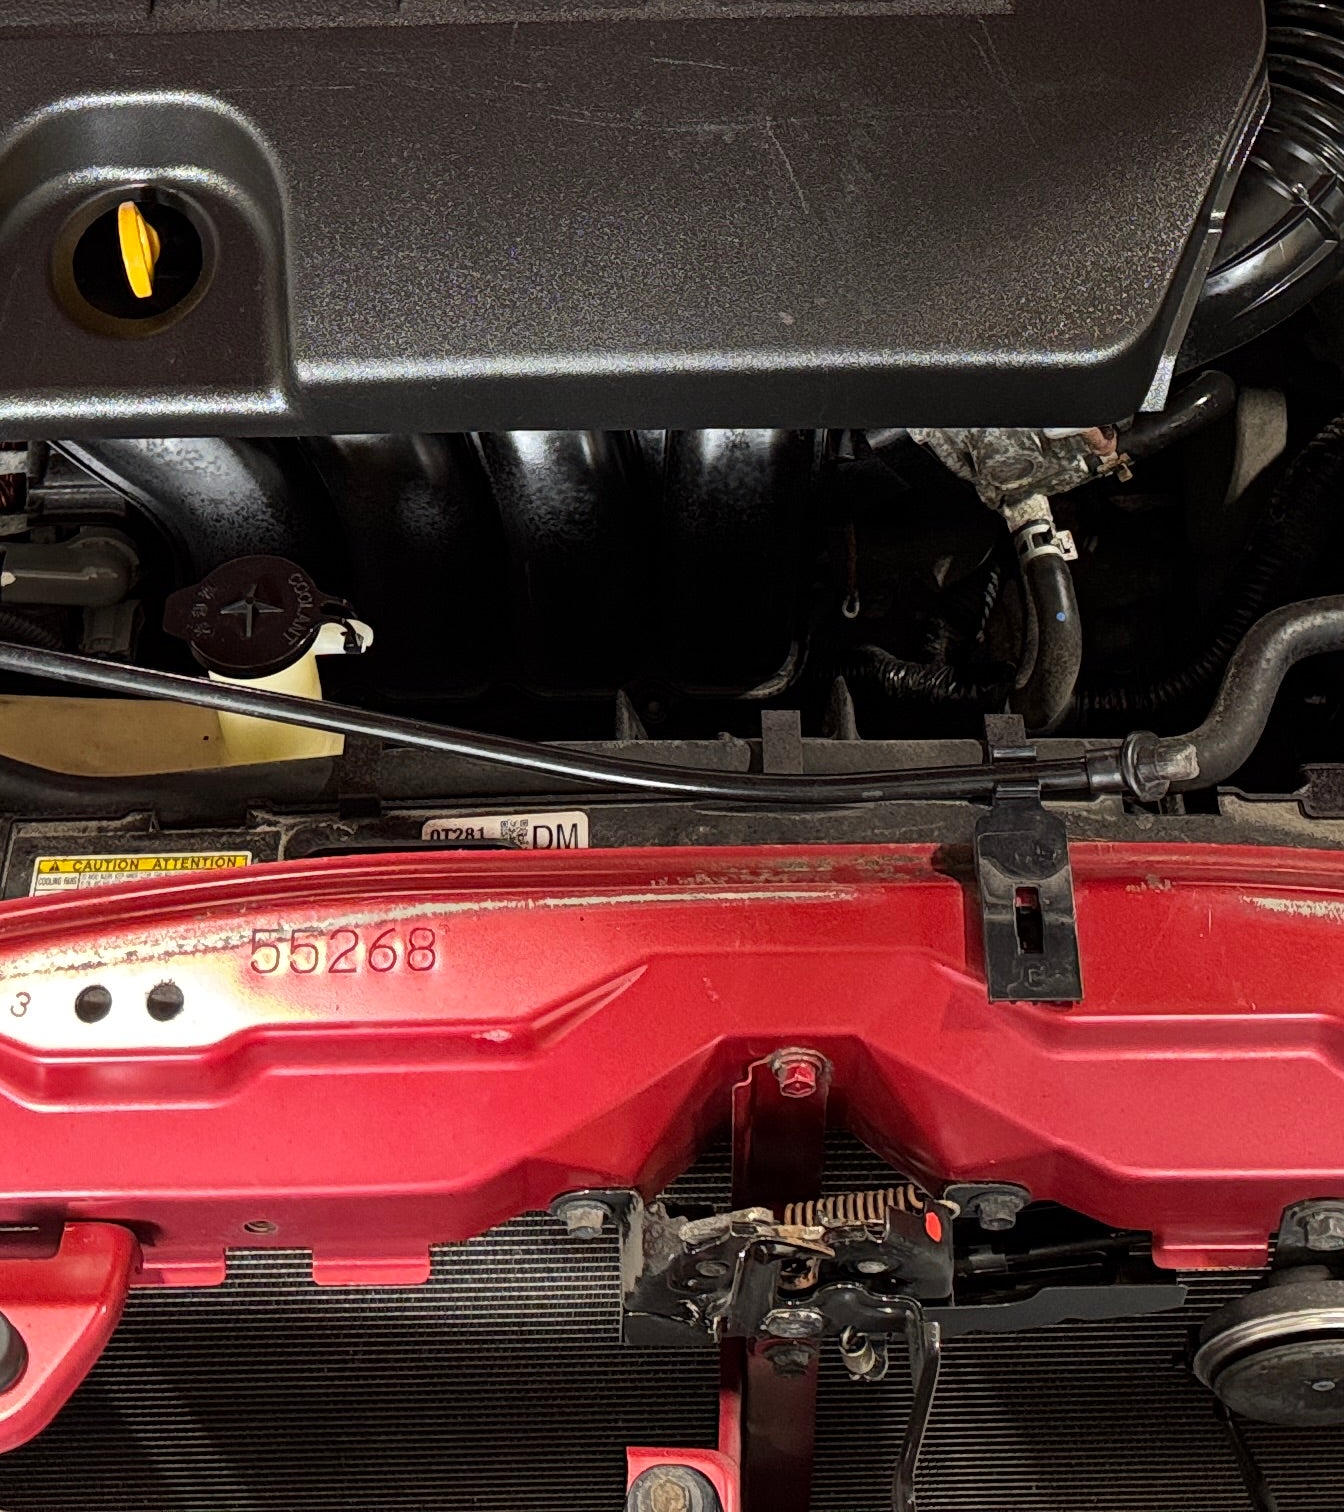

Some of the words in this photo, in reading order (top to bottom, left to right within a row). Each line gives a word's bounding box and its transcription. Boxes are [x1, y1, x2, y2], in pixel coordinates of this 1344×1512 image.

[282, 572, 315, 647] COOLANT
[532, 823, 580, 850] DM
[72, 859, 140, 872] CAUTION
[152, 856, 237, 870] ATTENTION
[249, 926, 438, 975] 55268
[9, 990, 33, 1019] 3
